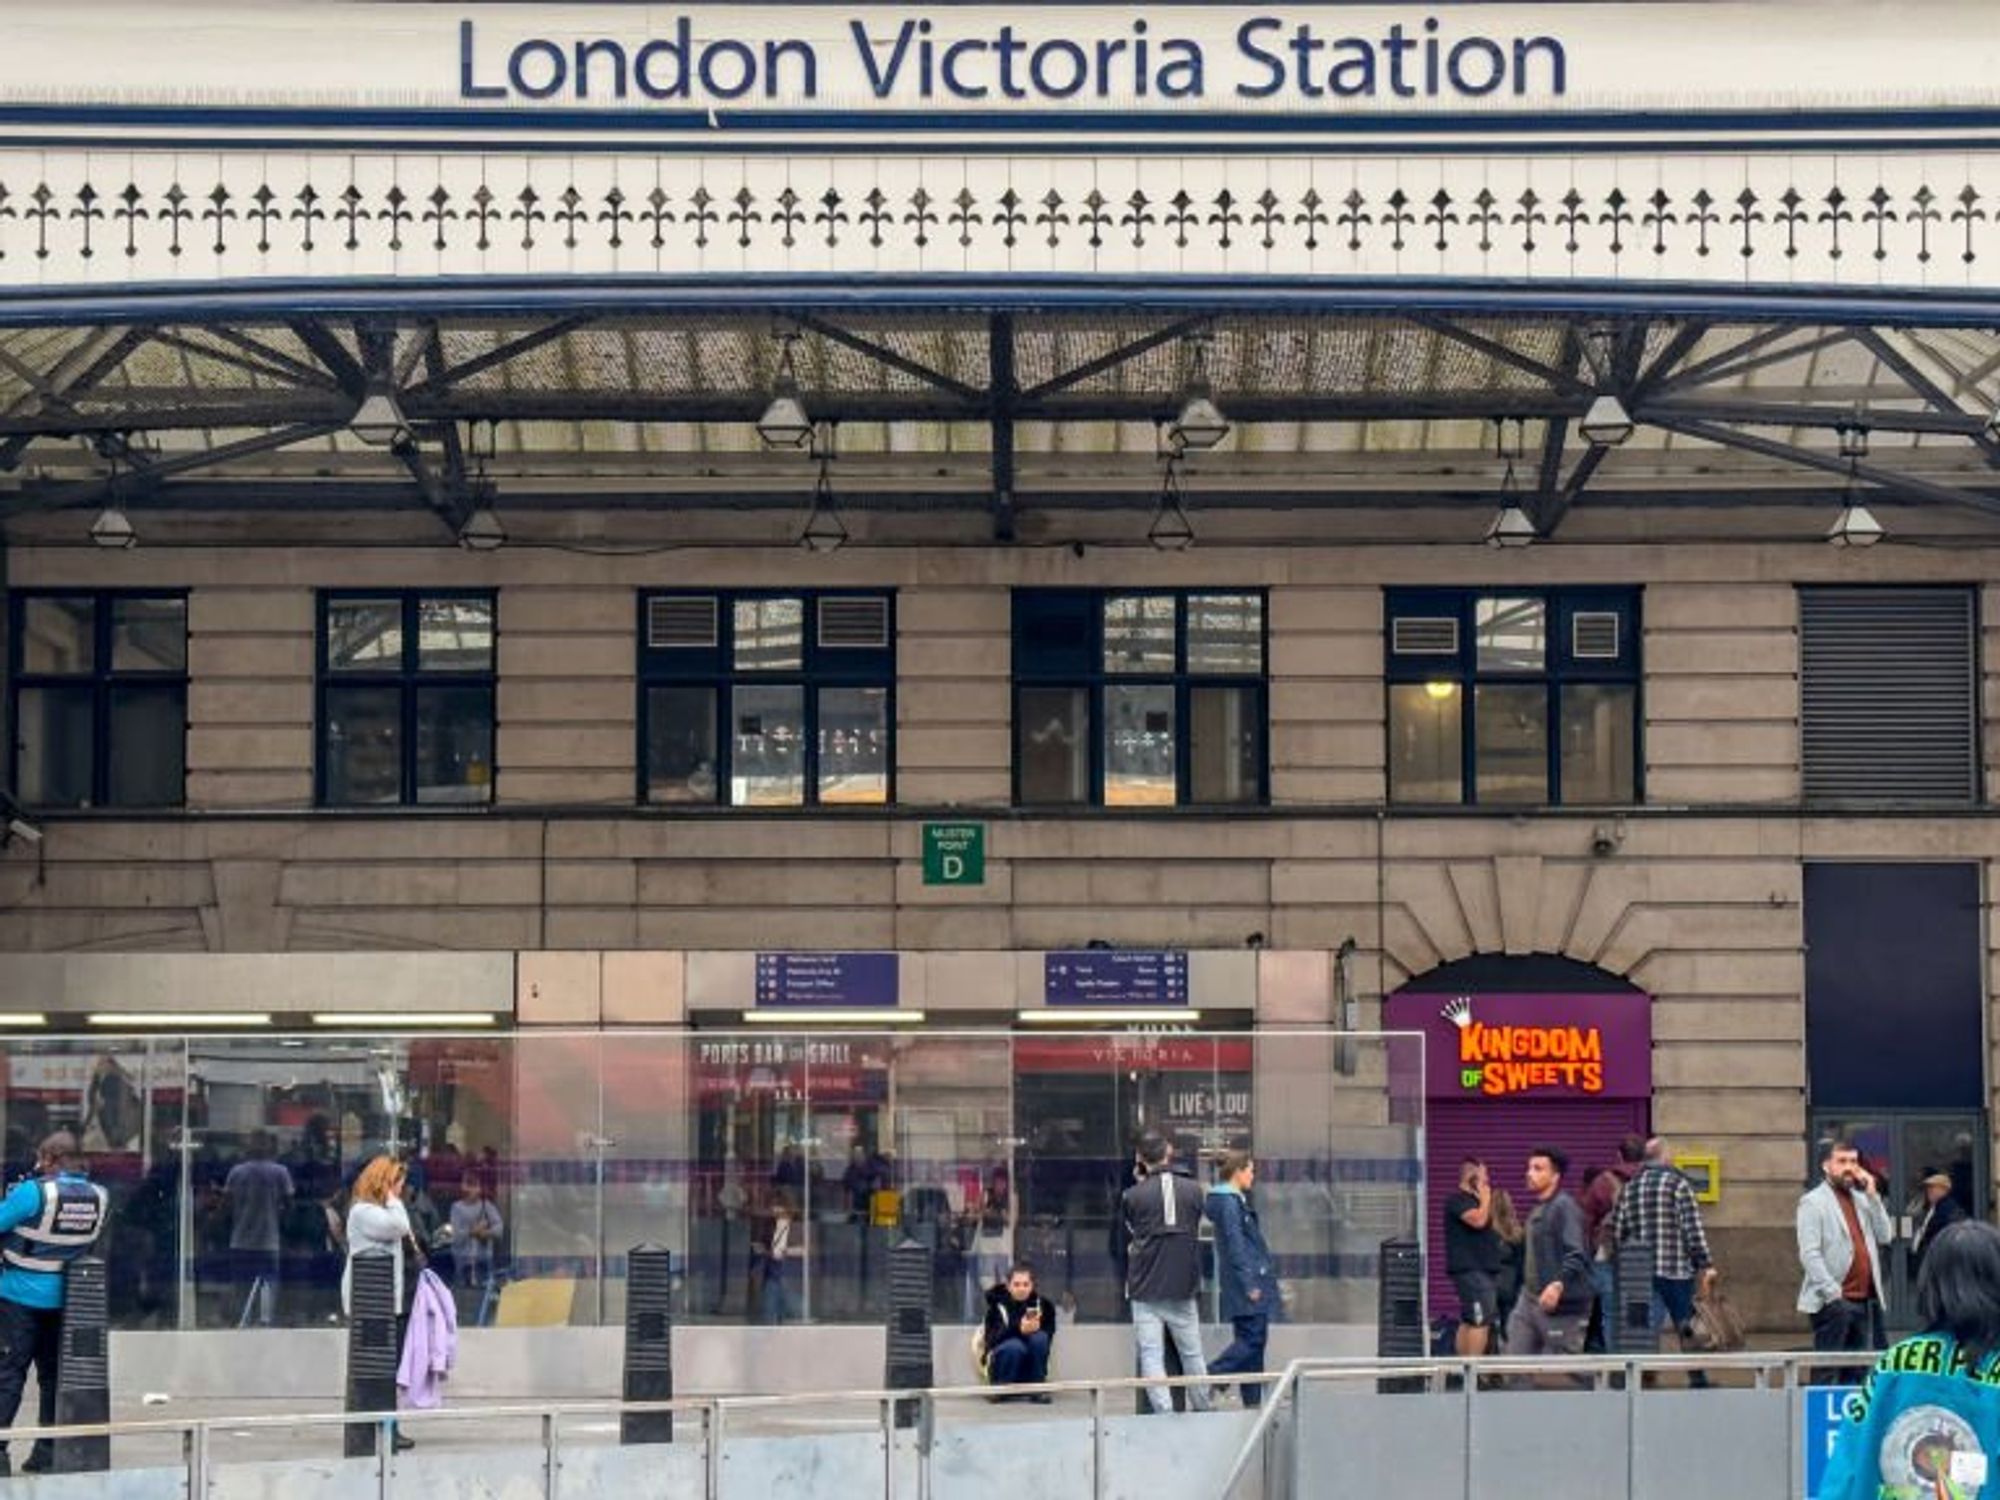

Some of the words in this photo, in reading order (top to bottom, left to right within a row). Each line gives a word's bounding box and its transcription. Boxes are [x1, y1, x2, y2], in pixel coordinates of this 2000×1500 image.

[461, 17, 816, 99] London
[850, 18, 1204, 99] Victoria
[1236, 17, 1567, 99] Station
[943, 856, 963, 879] D
[1460, 1022, 1602, 1062] KINGDOM
[1461, 1069, 1483, 1088] OF
[1483, 1061, 1604, 1096] SWEETS
[1169, 1092, 1205, 1116] LIVE
